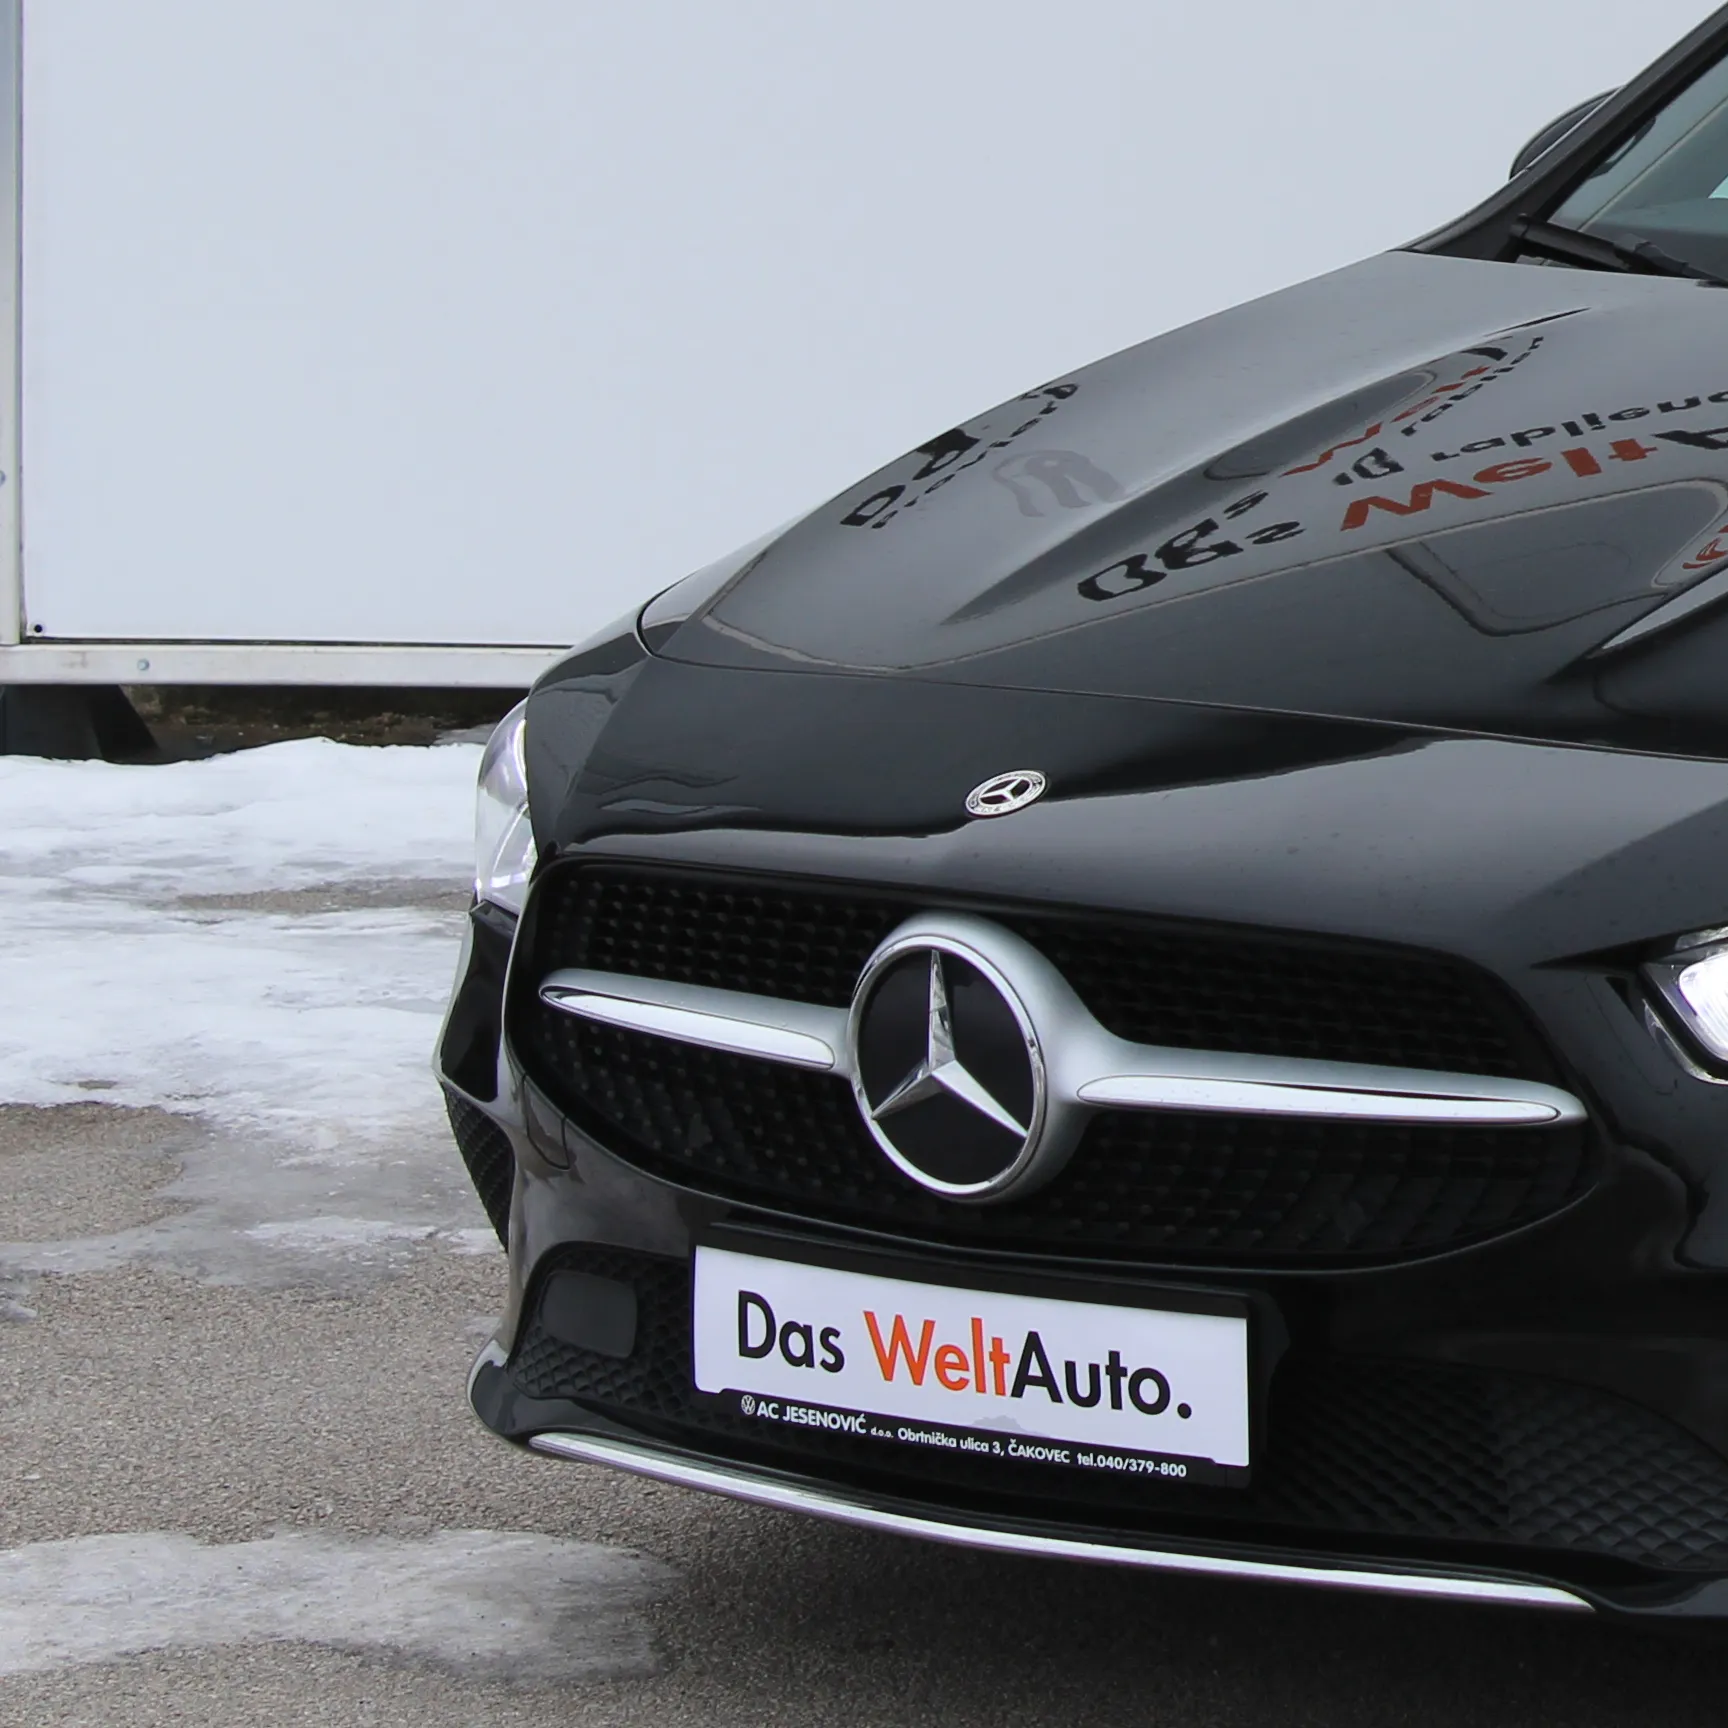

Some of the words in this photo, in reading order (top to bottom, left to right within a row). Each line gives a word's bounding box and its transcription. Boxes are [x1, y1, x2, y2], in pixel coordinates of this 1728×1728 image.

[737, 1289, 846, 1374] Das
[862, 1309, 1194, 1421] WeltAuto.
[757, 1401, 780, 1420] AC
[783, 1405, 868, 1434] JESENOVIĆ
[870, 1427, 895, 1439] d.o.o.
[897, 1427, 957, 1448] Obrtnička
[960, 1437, 990, 1453] ulica
[992, 1441, 1005, 1457] 3,
[1008, 1438, 1071, 1464] ČAKOVEC
[1077, 1452, 1188, 1478] tel.040/379-800
